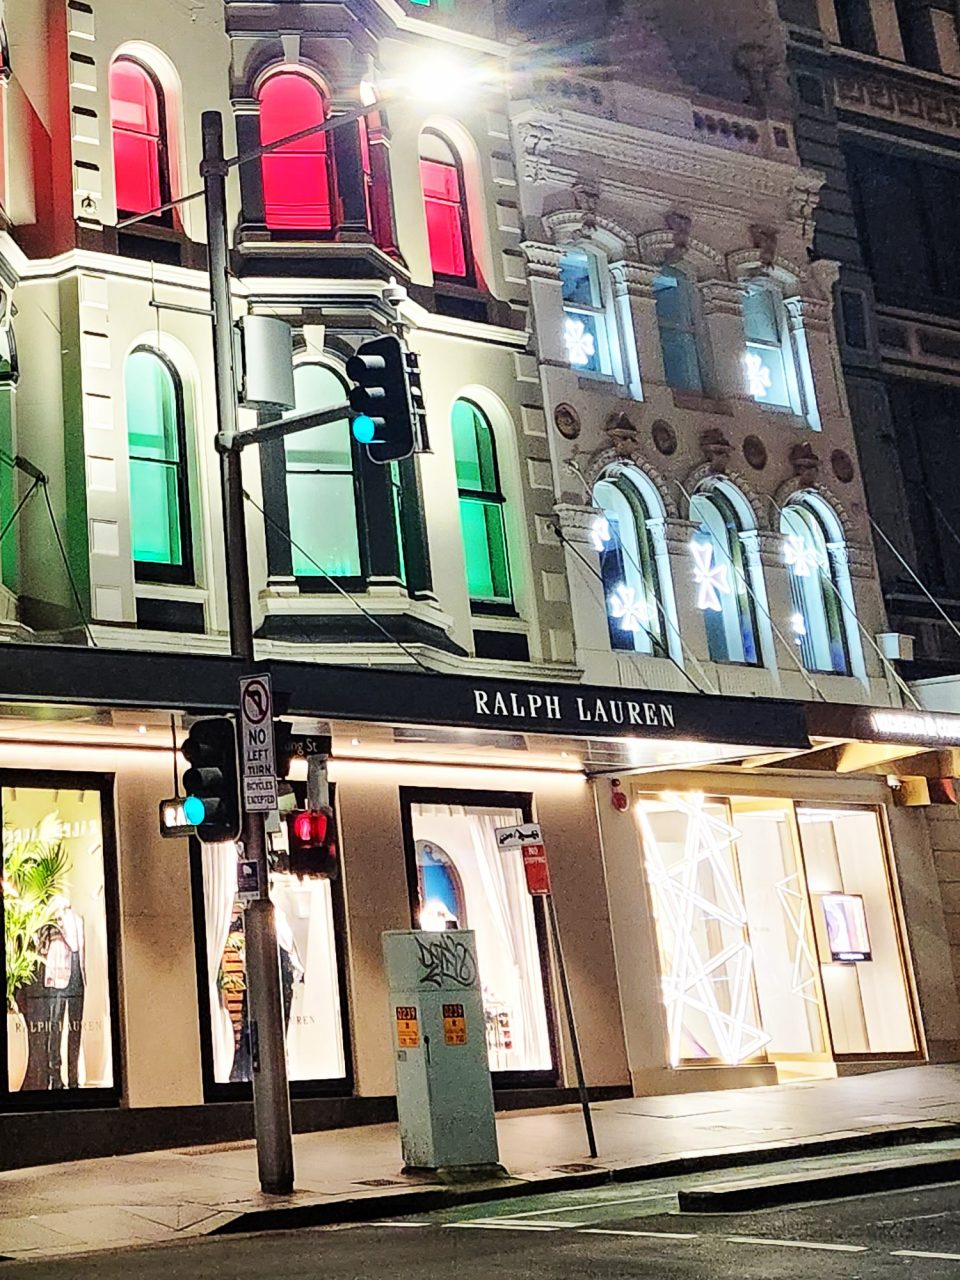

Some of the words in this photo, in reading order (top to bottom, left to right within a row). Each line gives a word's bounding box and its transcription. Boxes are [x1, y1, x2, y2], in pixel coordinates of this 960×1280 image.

[474, 689, 562, 720] RALPH
[576, 697, 676, 728] LAUREN
[248, 728, 266, 745] NO
[306, 738, 318, 752] St
[247, 749, 268, 761] LEFT
[247, 764, 271, 775] TURN
[246, 781, 273, 791] BICYCLES
[247, 794, 275, 805] EXCEPTED
[163, 806, 191, 827] RA
